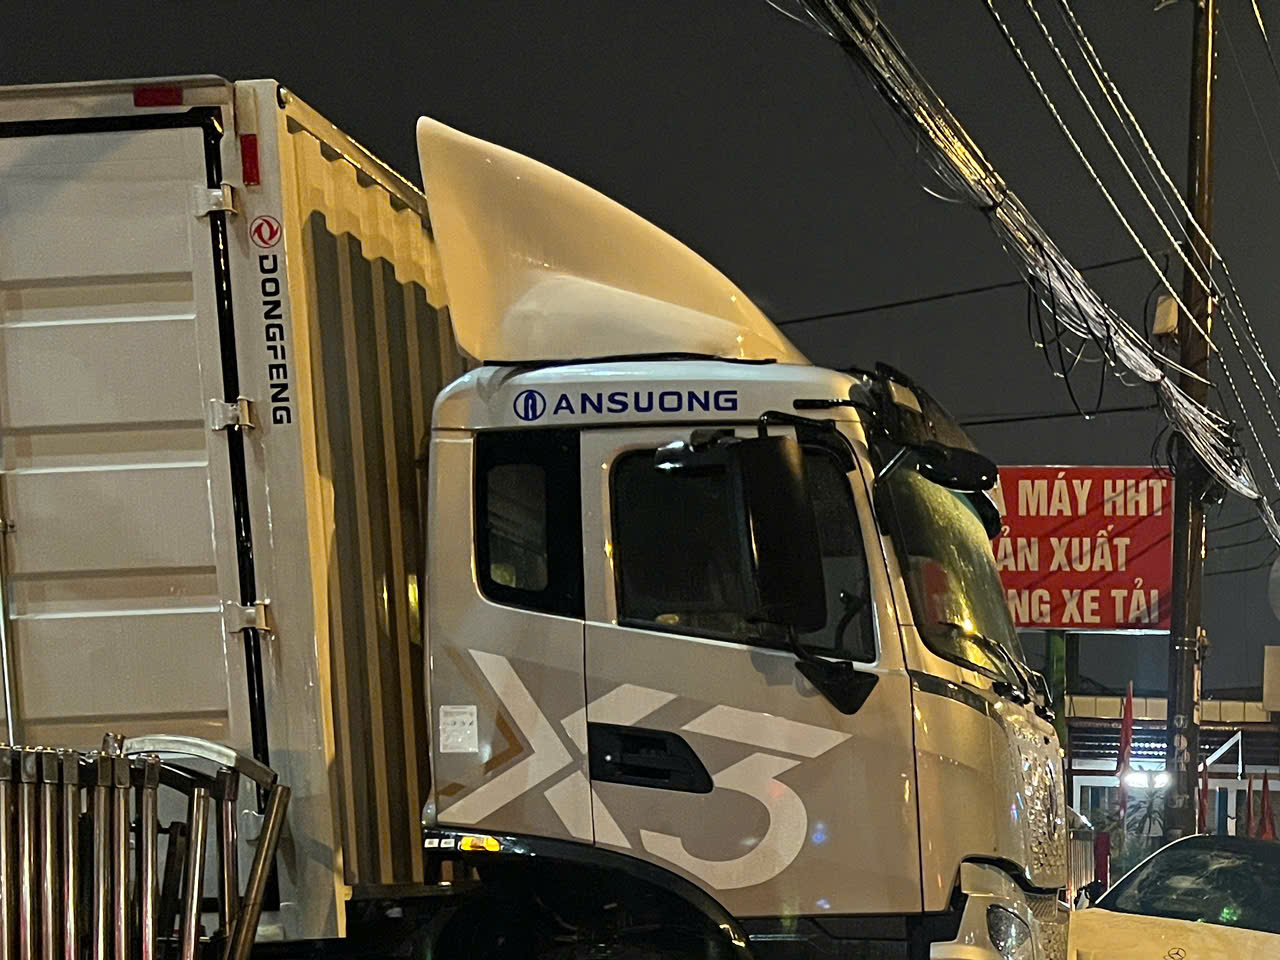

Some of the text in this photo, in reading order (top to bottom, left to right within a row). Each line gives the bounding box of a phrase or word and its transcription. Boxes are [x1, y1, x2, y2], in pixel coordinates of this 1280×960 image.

[258, 254, 292, 426] DONGFENG
[552, 390, 738, 415] ANSUONG
[1017, 471, 1093, 517] MÁY
[1103, 478, 1167, 517] HHT
[991, 524, 1131, 573] ẢN XUẤT
[1006, 577, 1160, 624] NG XE TẢI
